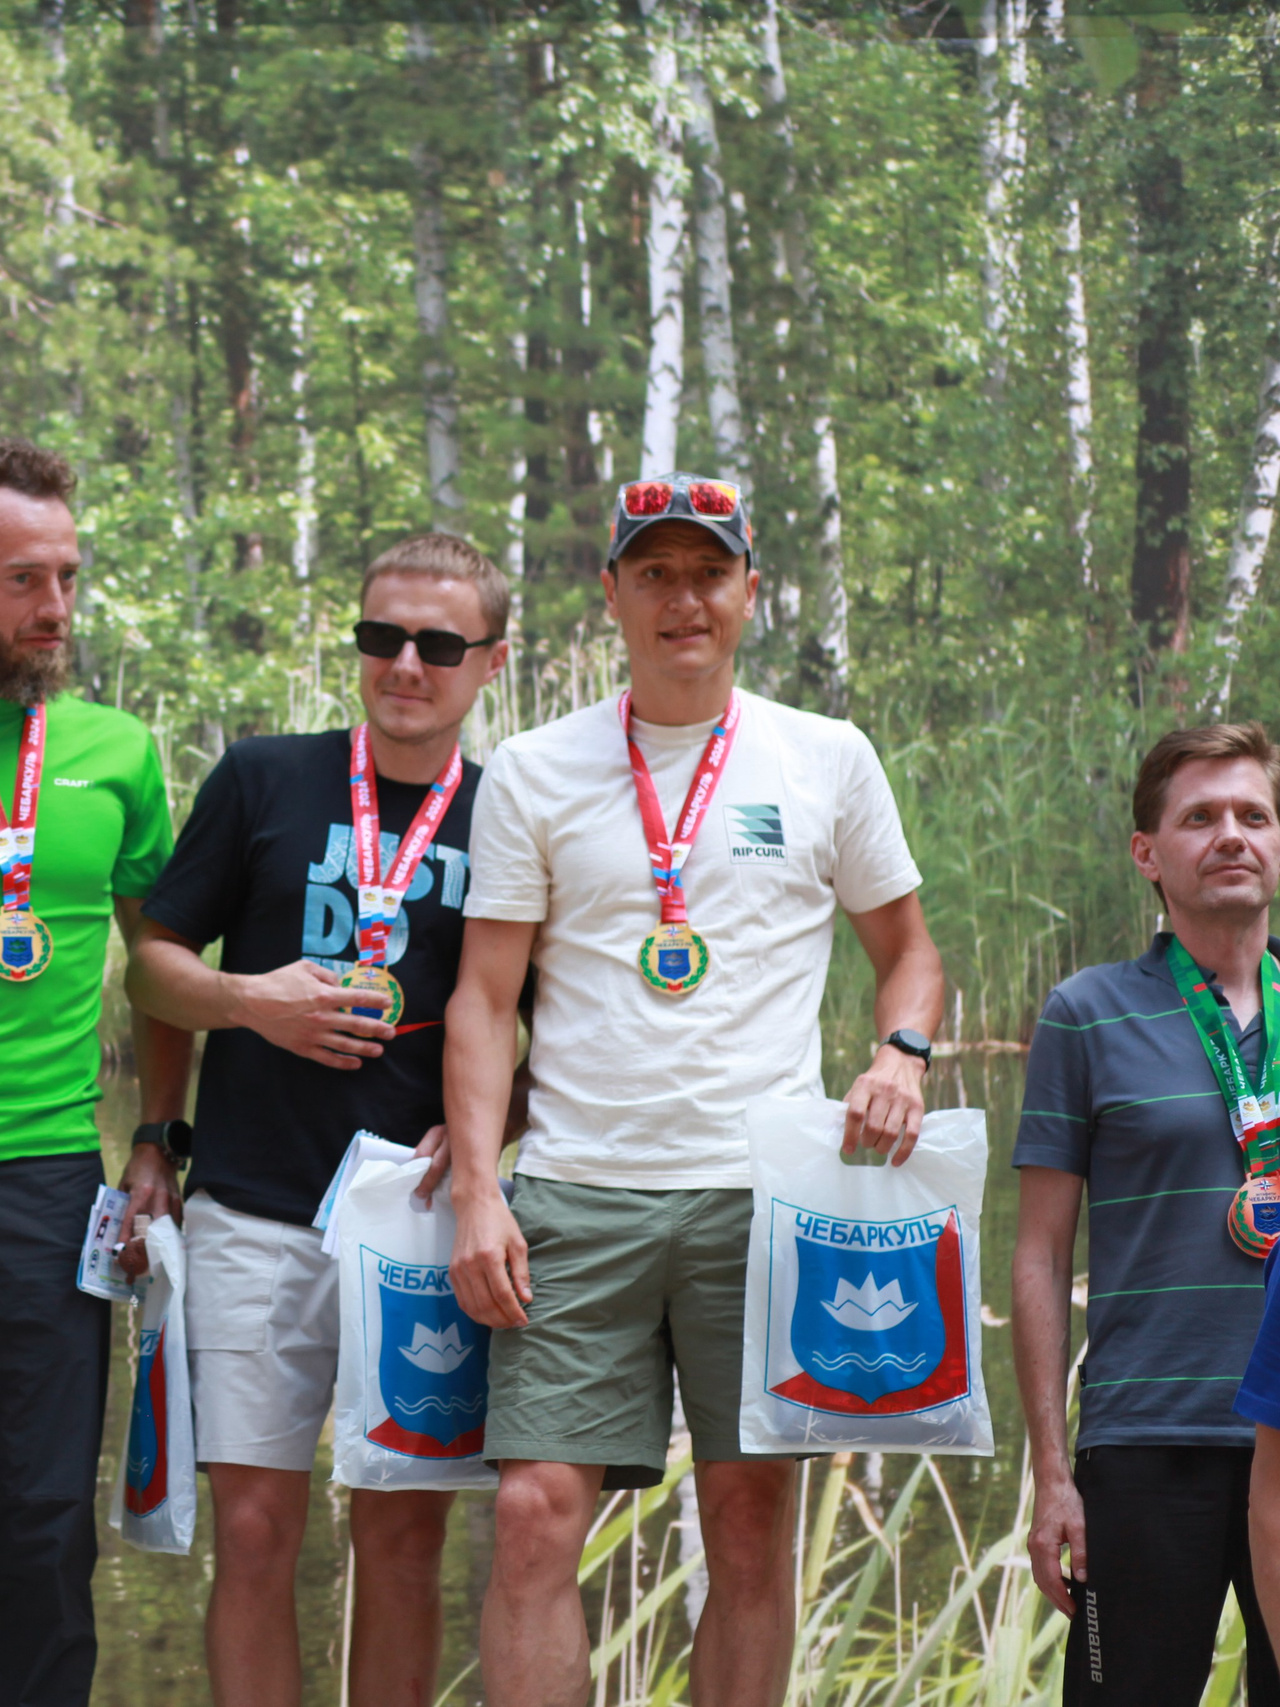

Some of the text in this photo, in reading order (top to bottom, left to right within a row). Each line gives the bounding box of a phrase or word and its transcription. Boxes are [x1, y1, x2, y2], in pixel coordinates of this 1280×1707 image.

[27, 718, 41, 746] 2024
[18, 751, 38, 822] ЧЕБАРКУЛЬ
[53, 777, 89, 788] CRAFT
[679, 737, 727, 839] ЧЕБАРКУЛЬ 2024
[391, 794, 444, 886] ЧЕБАРКУЛЬ 2024
[732, 846, 785, 859] RIP CURL
[795, 1211, 945, 1248] ЧЕБАРКУЛЬ
[1086, 1588, 1104, 1684] noname
